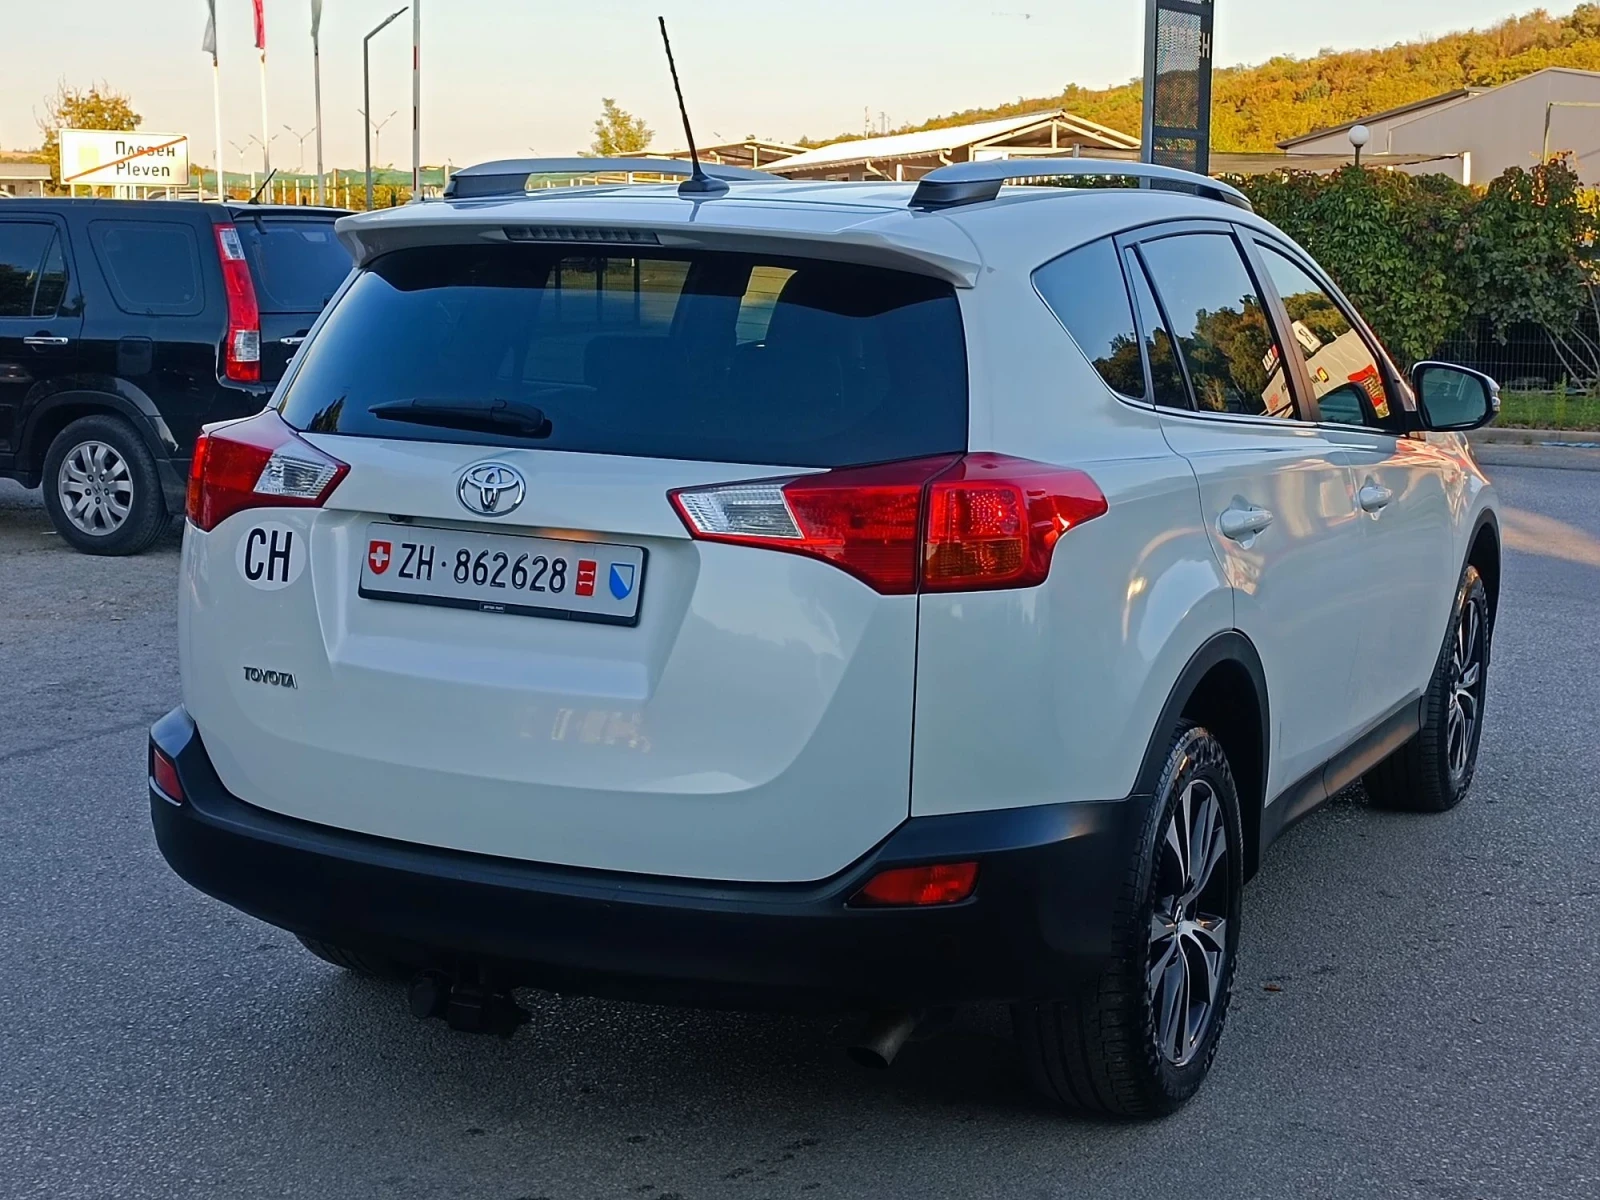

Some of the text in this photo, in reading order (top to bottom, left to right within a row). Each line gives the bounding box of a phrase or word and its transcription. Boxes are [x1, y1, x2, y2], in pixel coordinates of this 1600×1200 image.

[116, 161, 170, 177] Pleven
[244, 527, 293, 582] CH
[243, 666, 298, 690] TOYOTA
